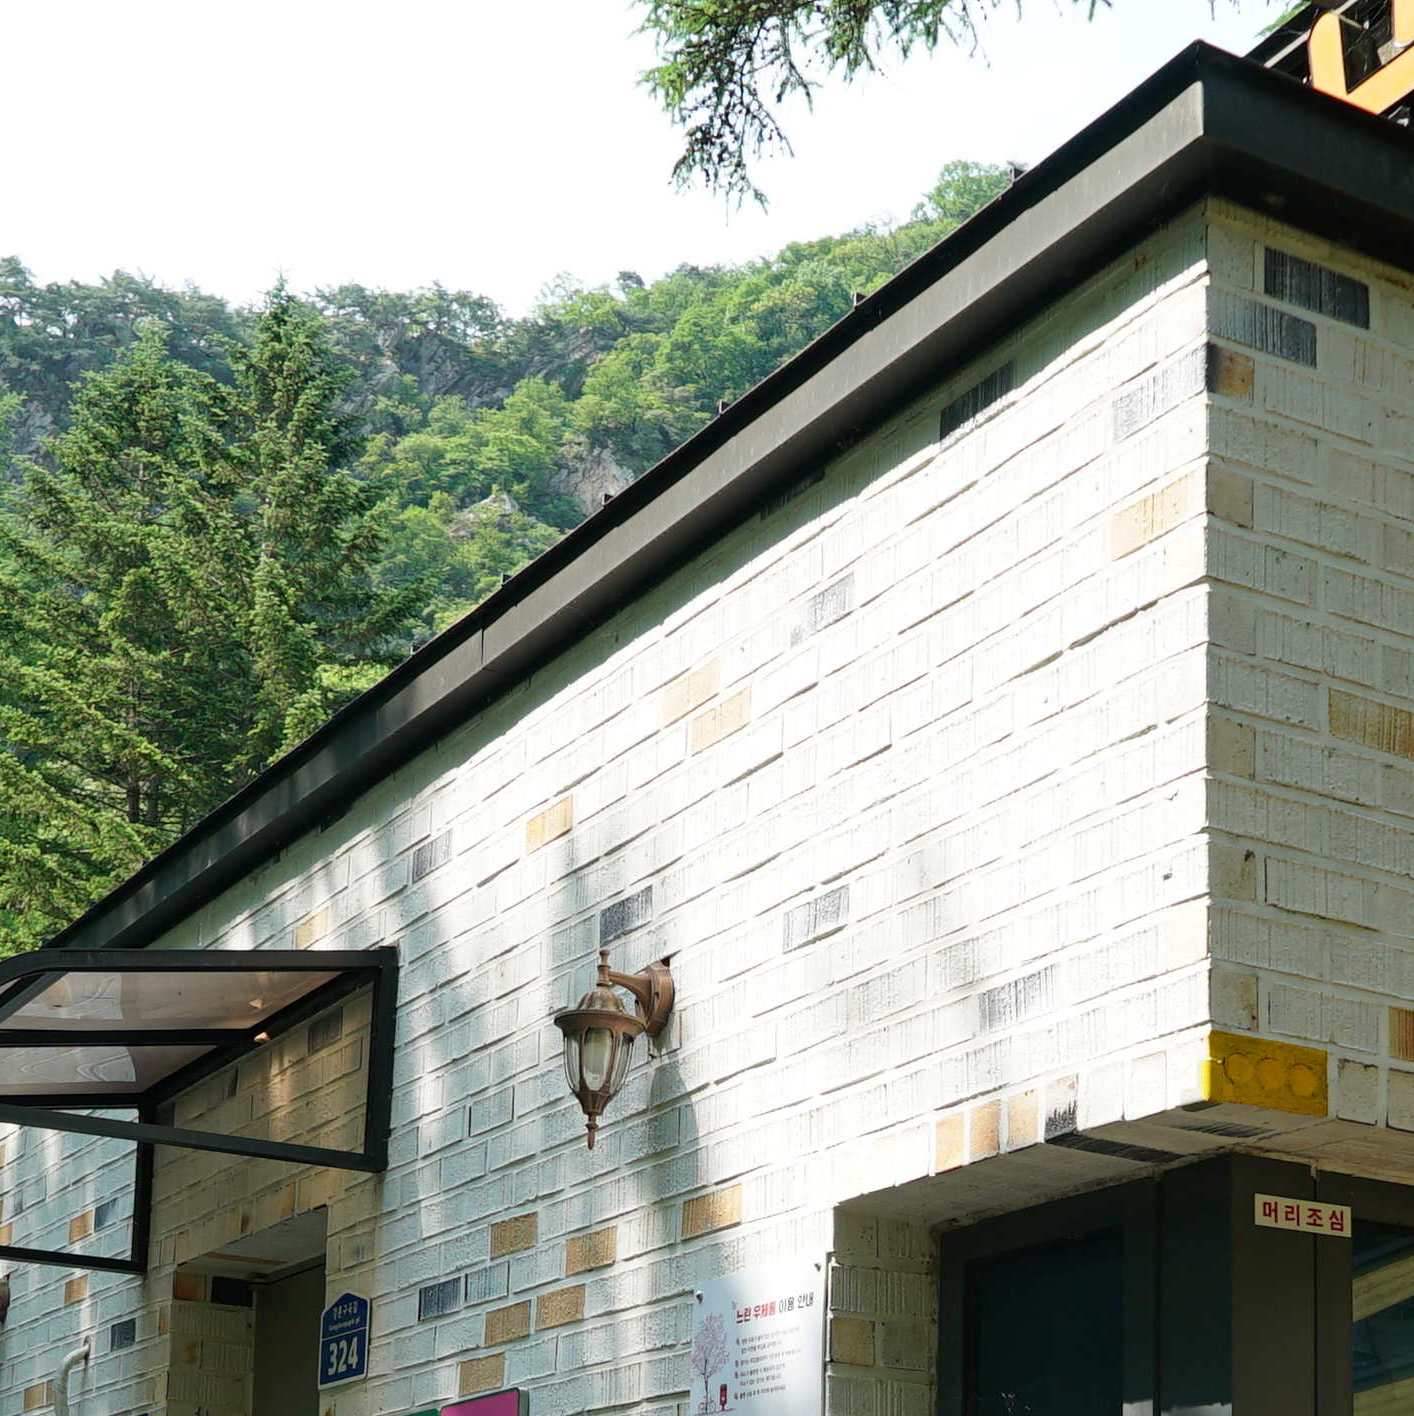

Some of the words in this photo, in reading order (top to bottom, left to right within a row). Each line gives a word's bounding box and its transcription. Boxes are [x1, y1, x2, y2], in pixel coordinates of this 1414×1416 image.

[1262, 1201, 1344, 1232] 머리조심
[736, 1306, 751, 1324] 느린
[779, 1297, 795, 1313] 이용
[797, 1291, 814, 1309] 안내
[327, 1336, 358, 1376] 324
